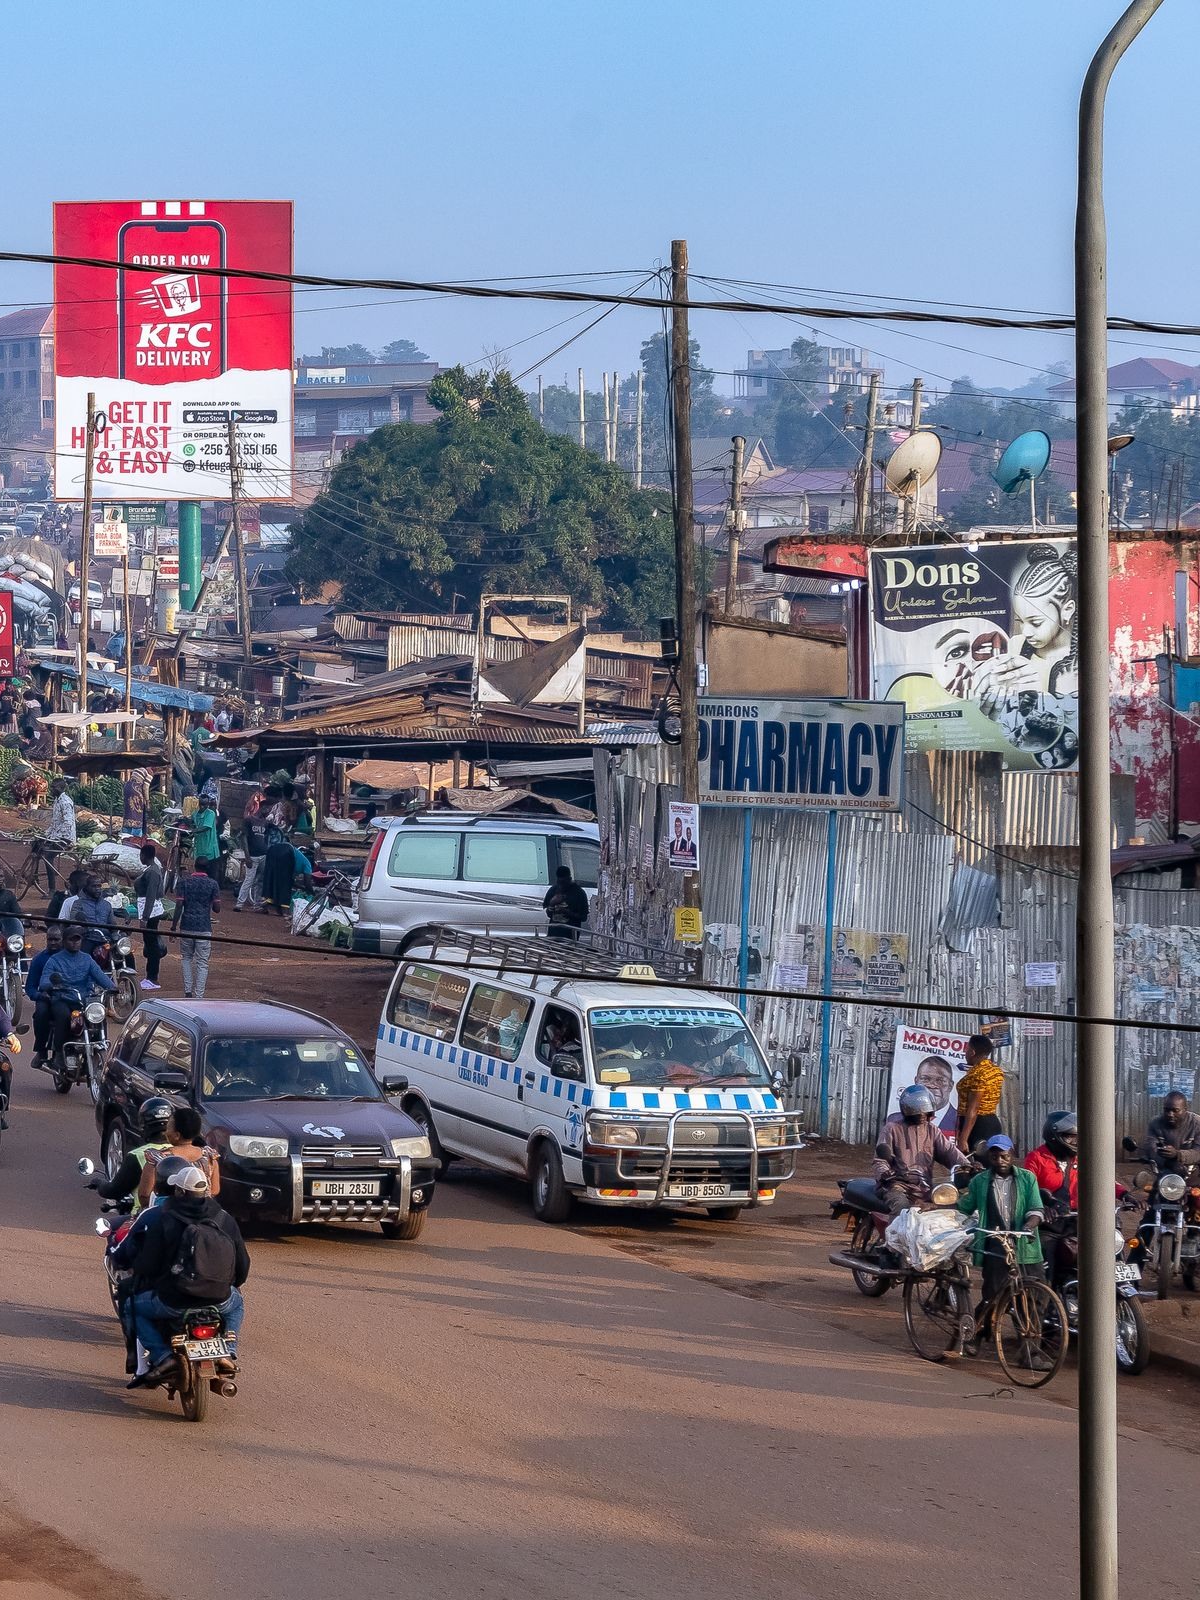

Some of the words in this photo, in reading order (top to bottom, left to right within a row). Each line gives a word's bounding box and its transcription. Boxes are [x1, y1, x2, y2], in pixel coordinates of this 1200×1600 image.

[133, 255, 175, 265] ORDER
[182, 255, 210, 266] NOW
[136, 323, 212, 348] KFC
[136, 351, 211, 366] DELIVERY
[109, 401, 147, 424] GET
[153, 401, 171, 424] IT
[122, 427, 171, 448] FAST
[200, 444, 222, 455] +256
[243, 444, 258, 455] 551
[261, 444, 277, 455] 156
[96, 451, 113, 473] &
[120, 451, 171, 473] EASY
[883, 558, 980, 589] Dons
[942, 588, 997, 610] Salon
[698, 794, 722, 803] TAIL,
[726, 795, 775, 804] EFFECTIVE
[778, 797, 800, 805] SAFE
[804, 798, 837, 806] HUMAN
[628, 967, 651, 976] TAXI
[903, 1043, 946, 1057] EMMANUEL
[948, 1051, 966, 1060] MAT
[325, 1184, 344, 1194] UBH
[349, 1184, 374, 1194] 283U
[681, 1185, 699, 1197] UBD
